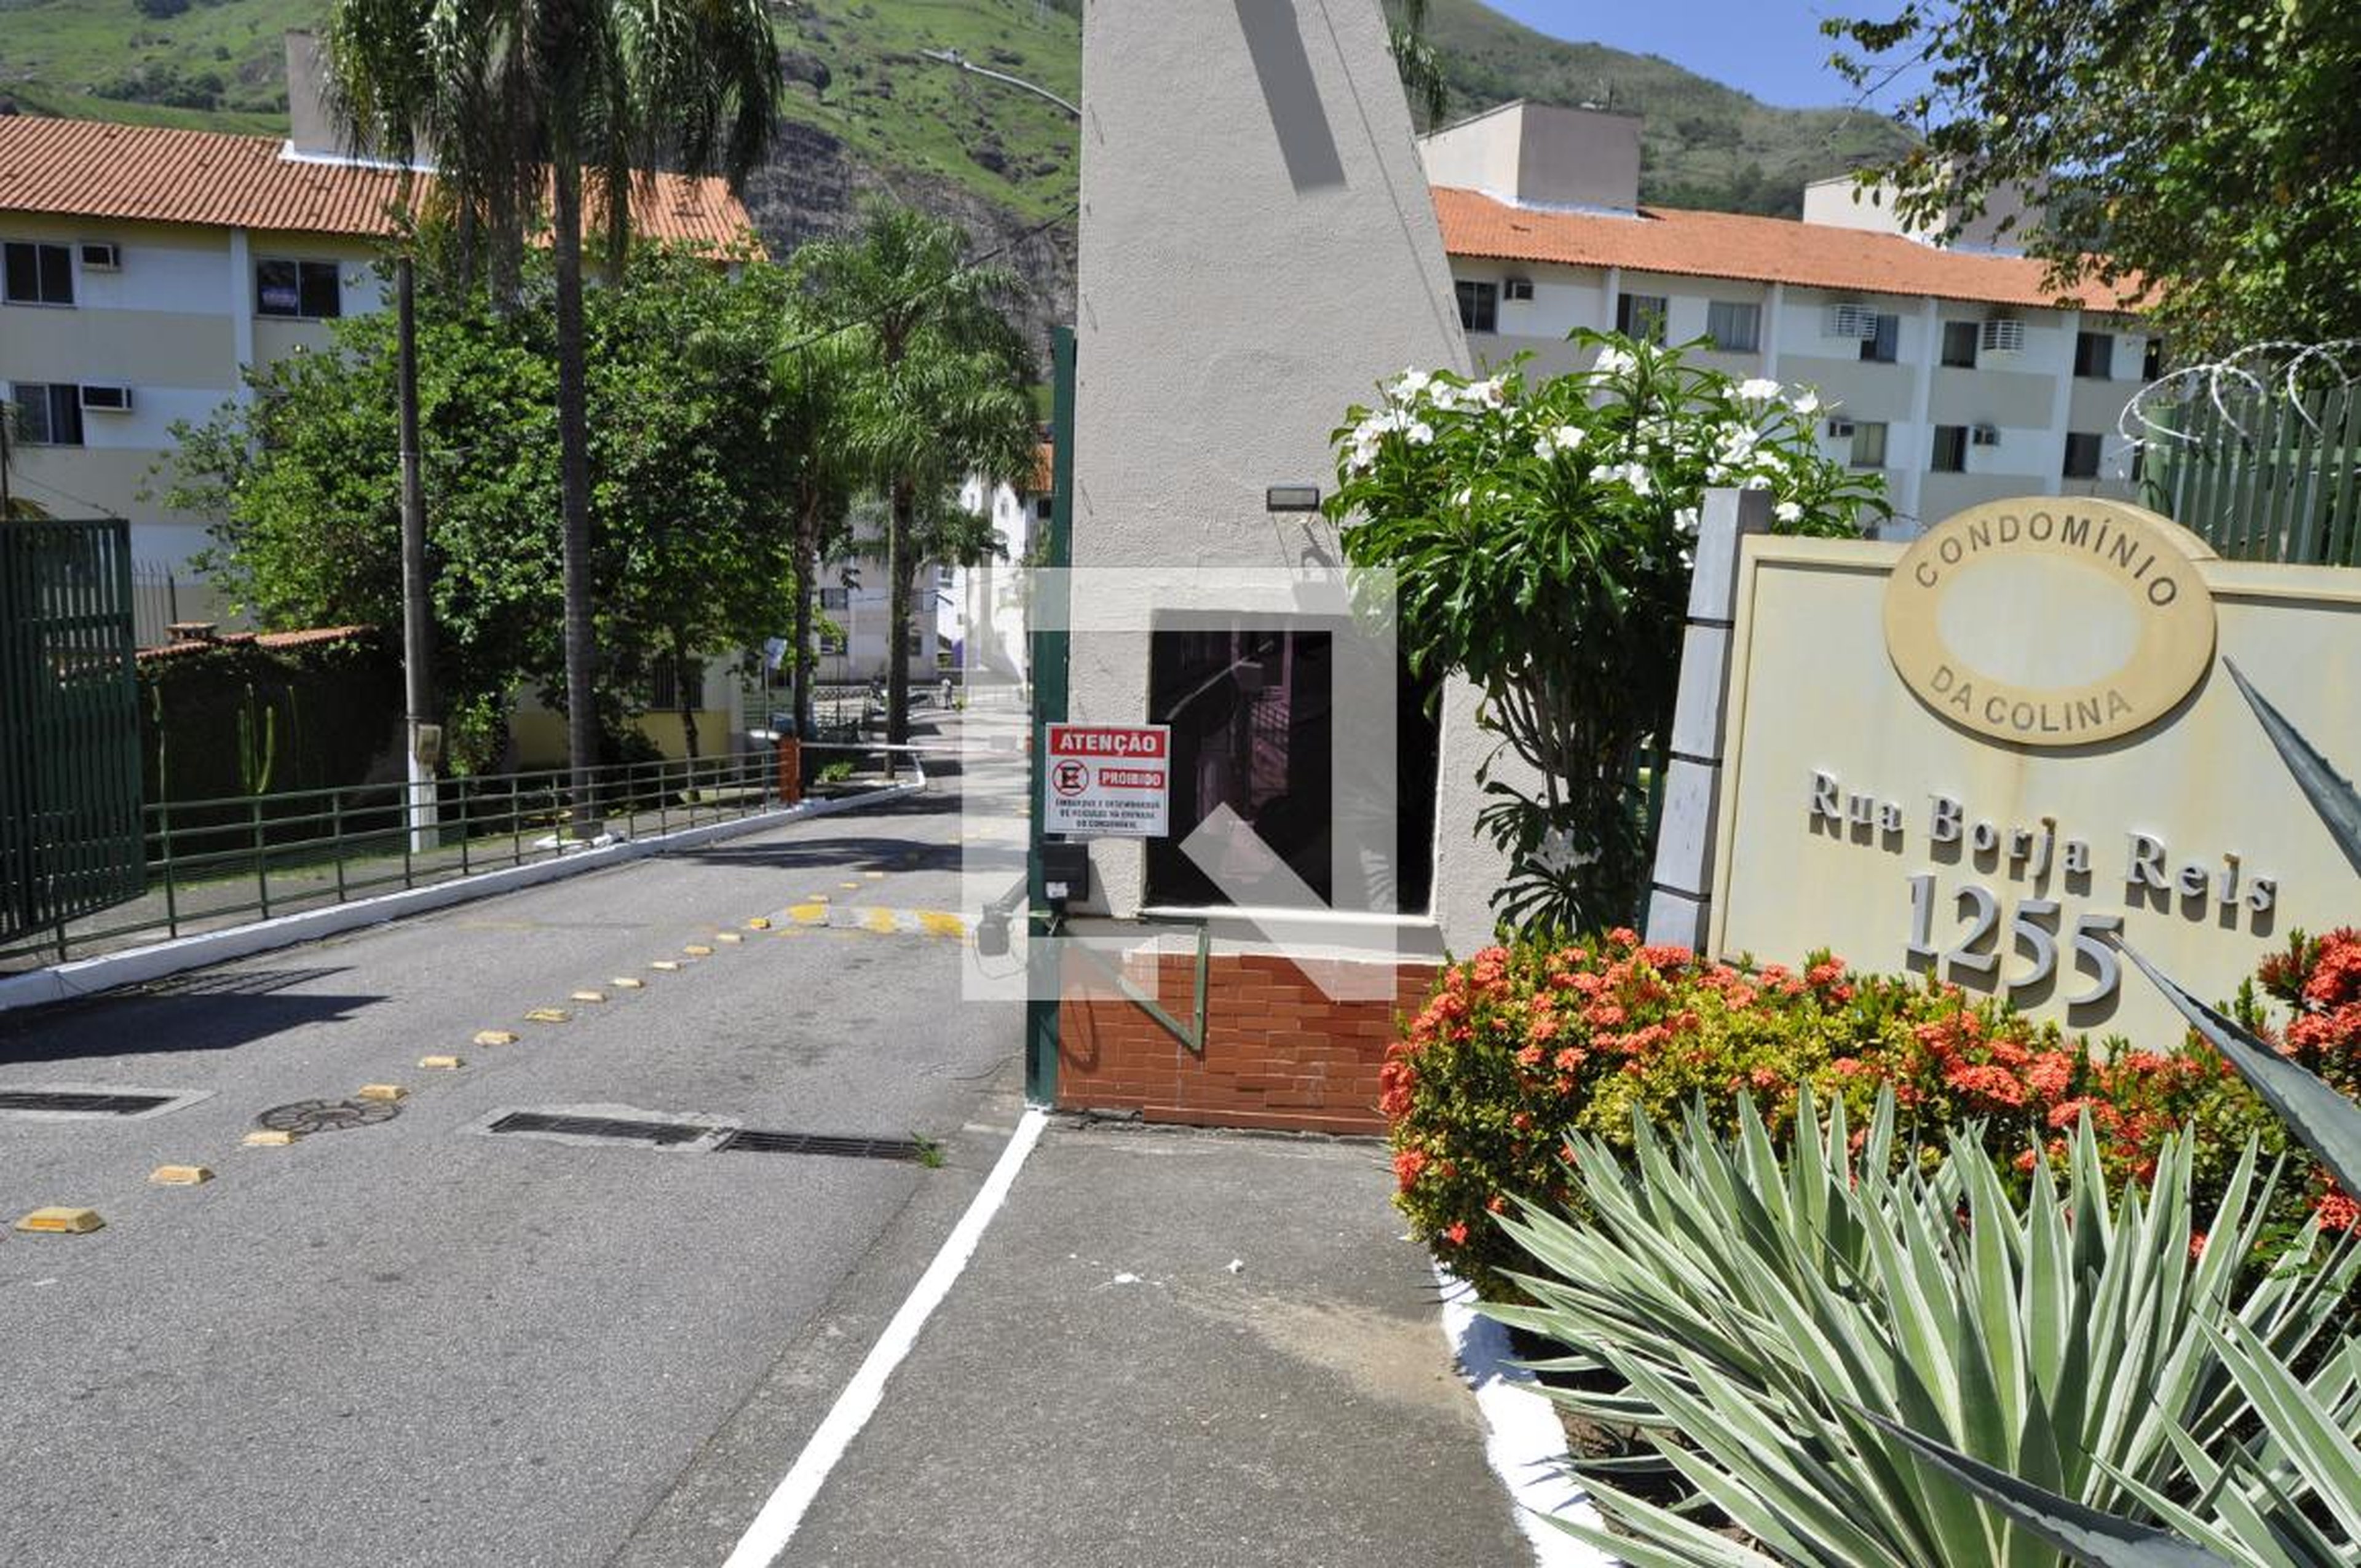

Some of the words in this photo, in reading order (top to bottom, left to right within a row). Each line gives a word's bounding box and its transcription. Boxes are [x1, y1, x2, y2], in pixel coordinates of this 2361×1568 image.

[1915, 511, 2177, 606] CONDOMÍNIO
[1930, 664, 1972, 713] DA
[1984, 688, 2133, 732] COLINA
[1059, 733, 1157, 756] ATENÇÃO
[1102, 771, 1161, 787] PROIBIDO
[1809, 768, 1904, 832] Rua
[1928, 794, 2091, 878] Borja
[2124, 832, 2277, 912] Reis
[1907, 873, 2124, 1004] 1255
